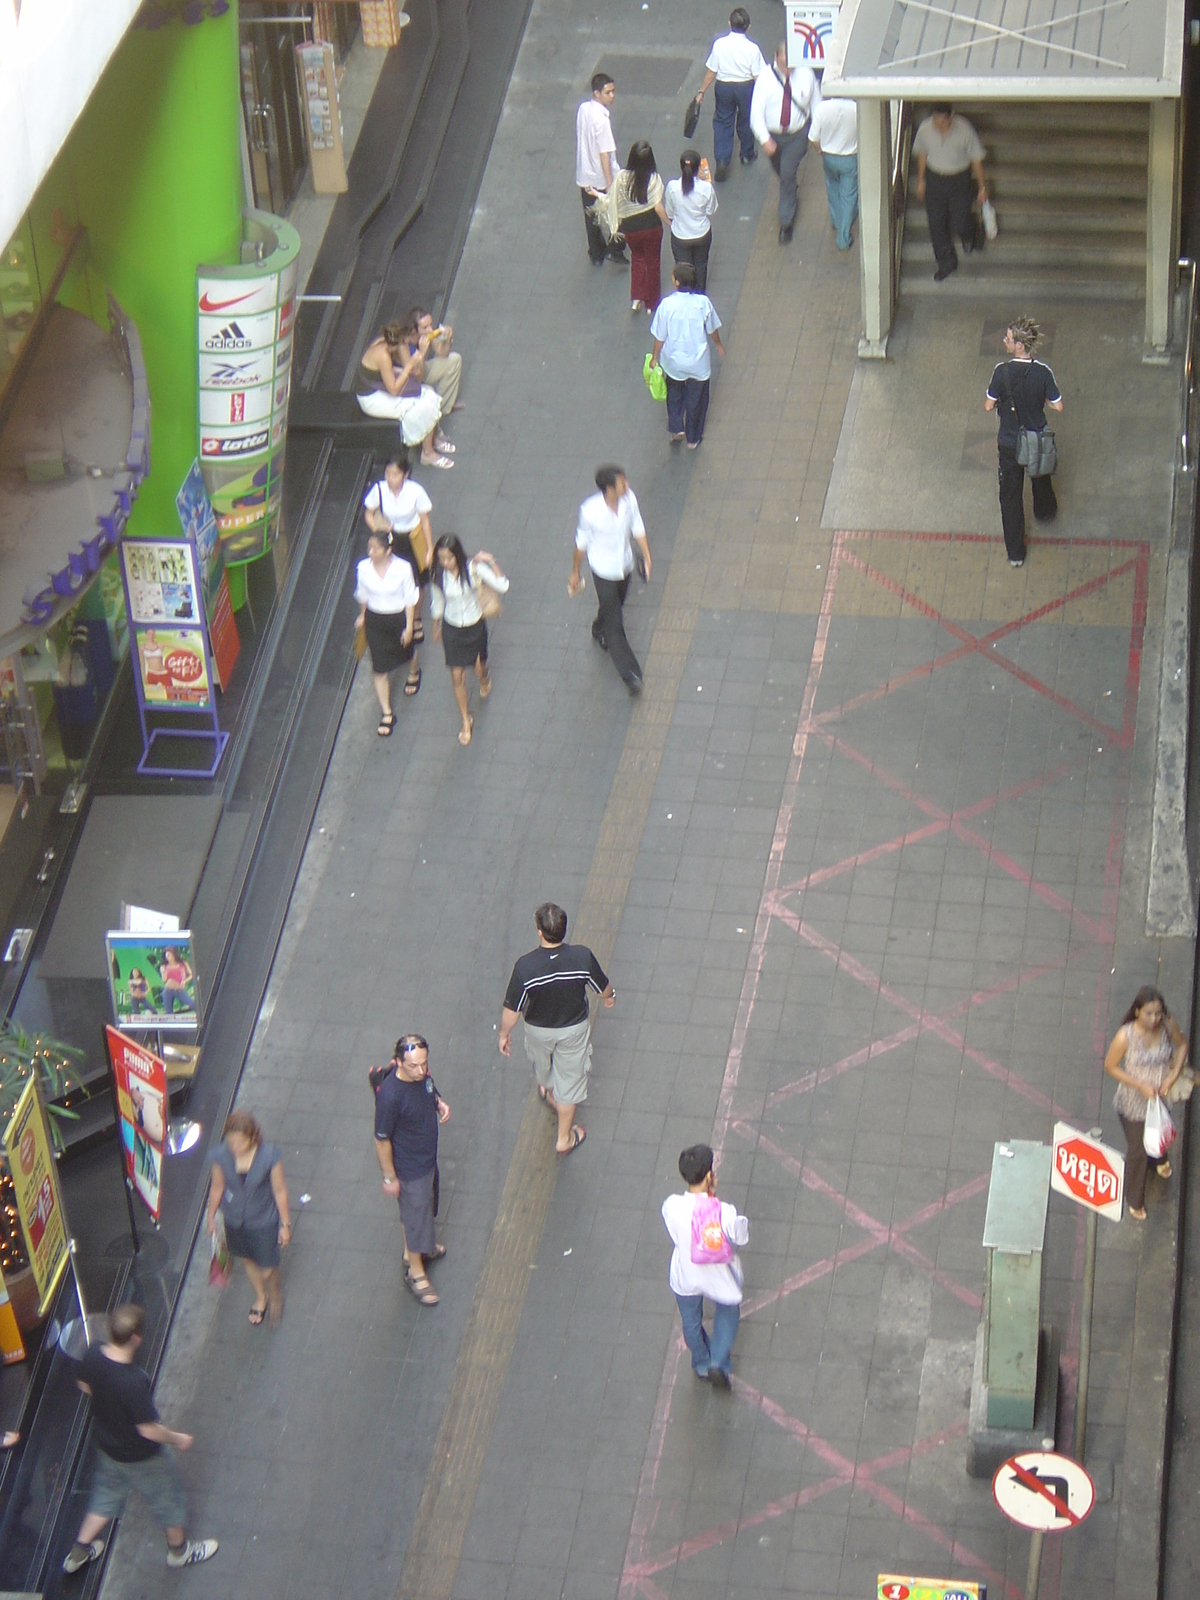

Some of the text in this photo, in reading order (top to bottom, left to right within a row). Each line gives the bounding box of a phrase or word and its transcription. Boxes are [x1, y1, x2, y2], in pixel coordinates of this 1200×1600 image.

[205, 338, 252, 349] adidas
[1059, 1147, 1117, 1201] หยุด
[889, 1585, 901, 1599] 1
